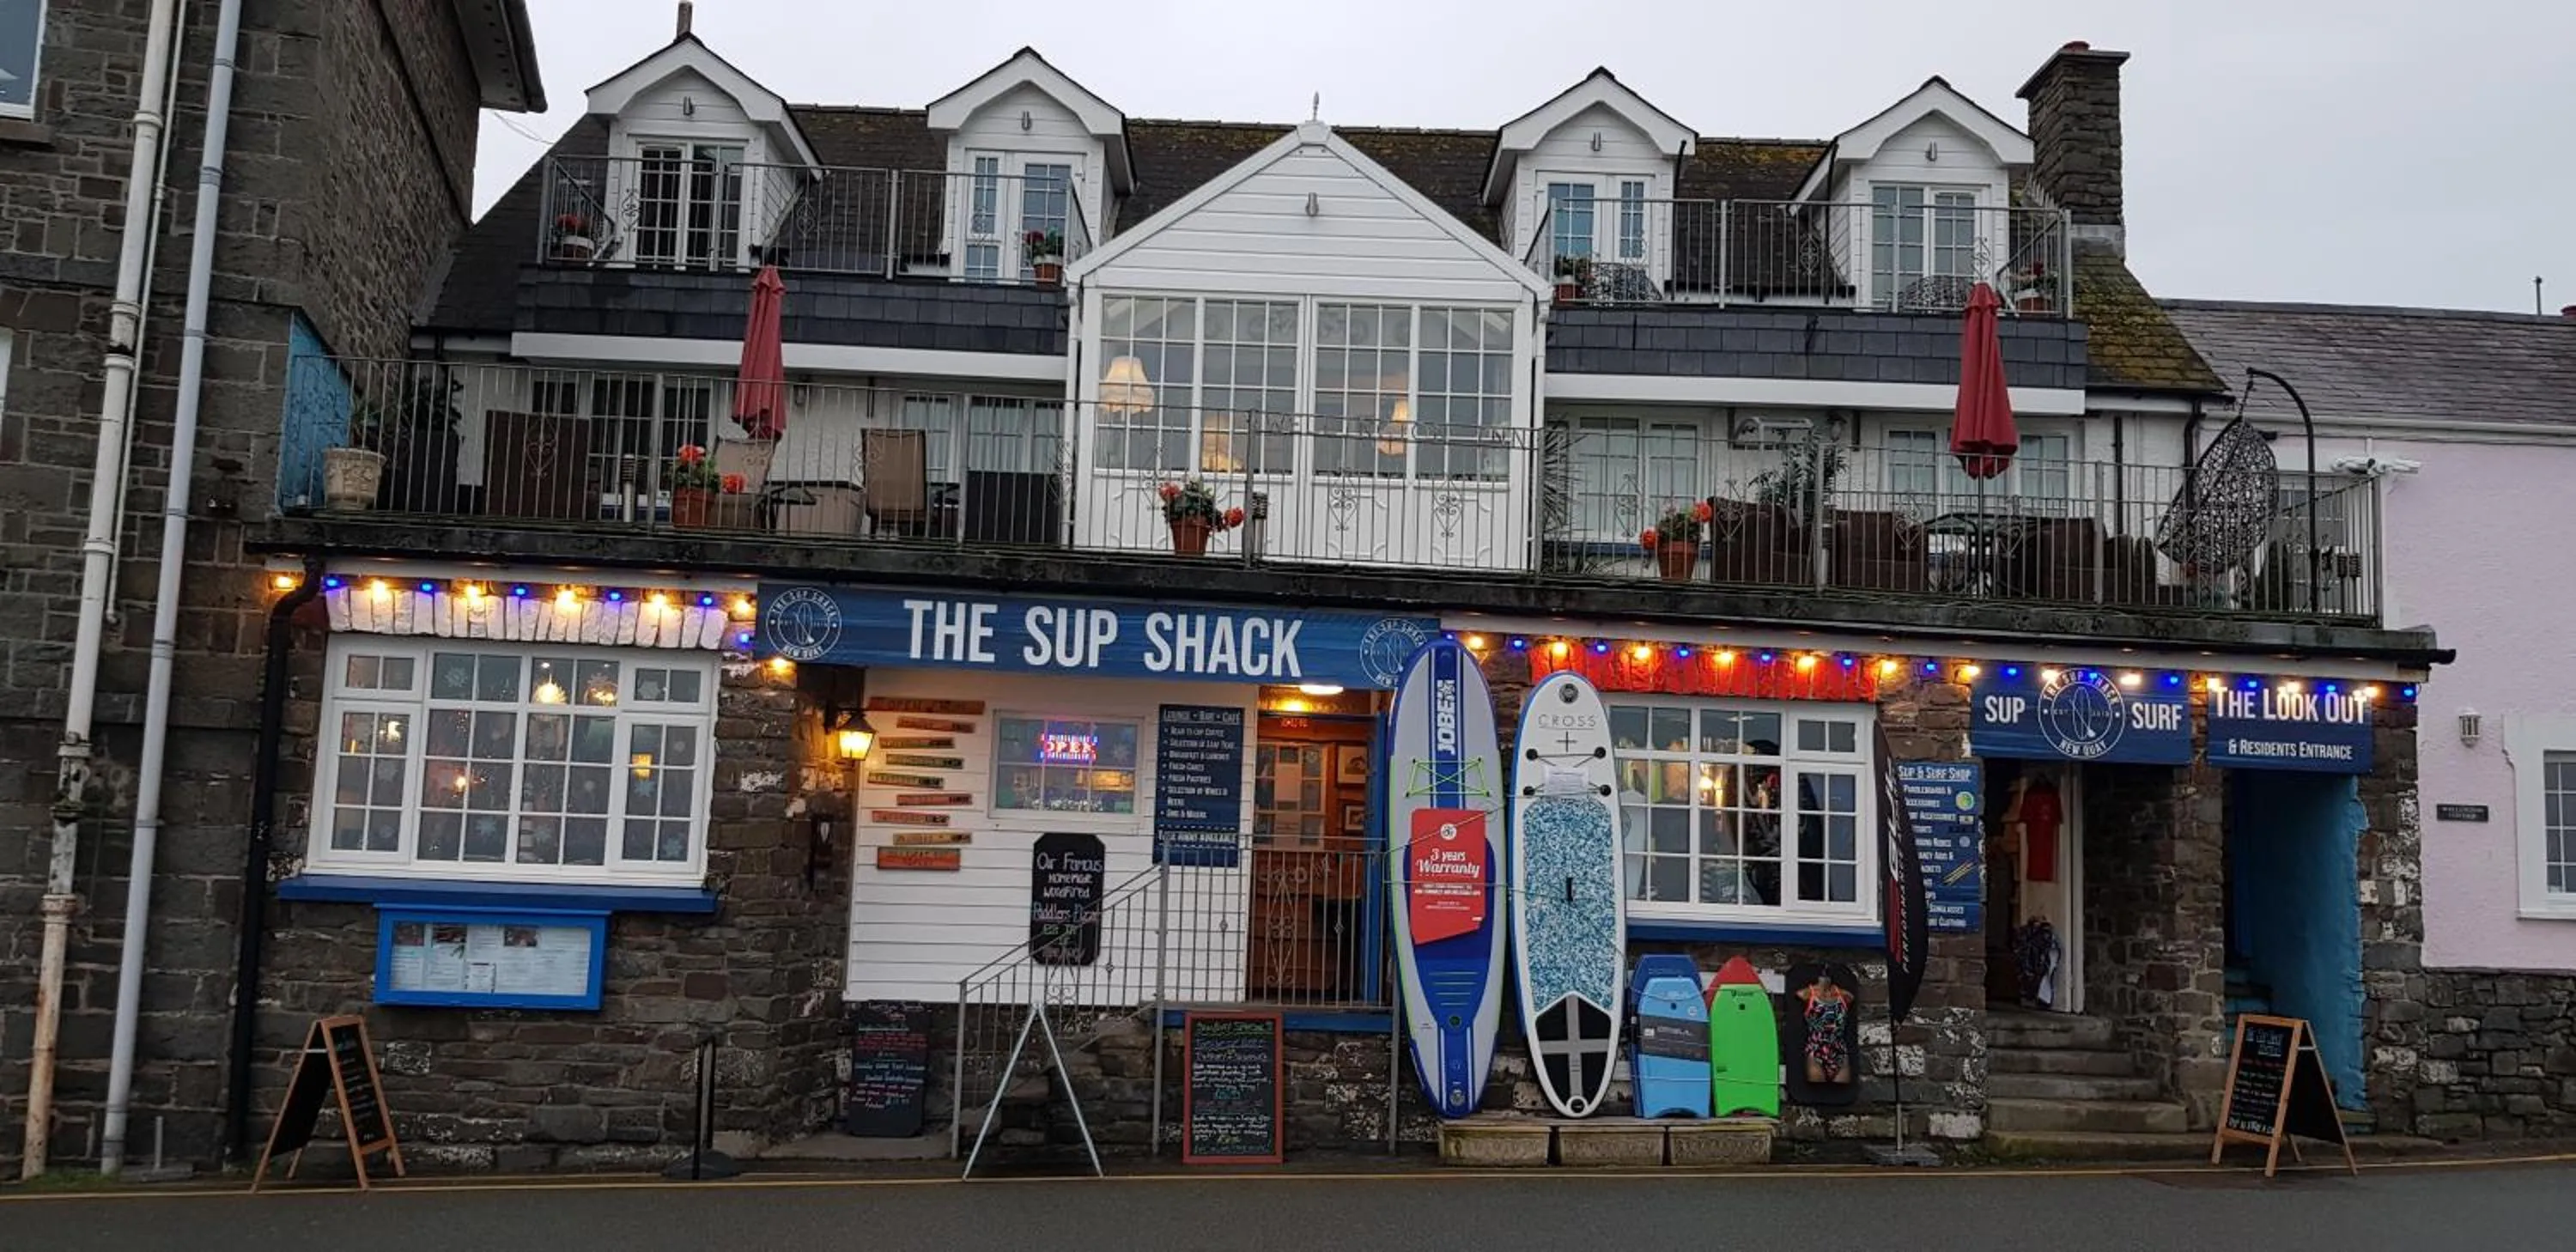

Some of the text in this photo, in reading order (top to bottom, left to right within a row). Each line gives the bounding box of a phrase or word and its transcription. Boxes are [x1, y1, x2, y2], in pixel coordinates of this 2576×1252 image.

[904, 599, 1303, 677] THE SUP SHACK
[2062, 672, 2083, 684] SUP
[1985, 696, 2025, 724] SUP
[2213, 687, 2367, 724] THE LOOK OUT
[1199, 710, 1214, 722] BAR
[1538, 714, 1596, 727] CROSS
[2132, 703, 2183, 731] SURF
[1437, 699, 1455, 756] JOBE
[1044, 741, 1096, 753] OPEN
[2059, 739, 2106, 756] NEW QUAY
[2228, 739, 2354, 760] & RESIDENTS ENTRANCE
[1898, 765, 1971, 781] SUP & SURF SHOP
[1904, 785, 1946, 794] PADDLEBOARDS
[1920, 811, 1956, 821] ACCESSORIES
[1431, 848, 1466, 862] 3 years
[1415, 859, 1480, 878] Warranty
[1899, 850, 1910, 974] PERFORMANCE
